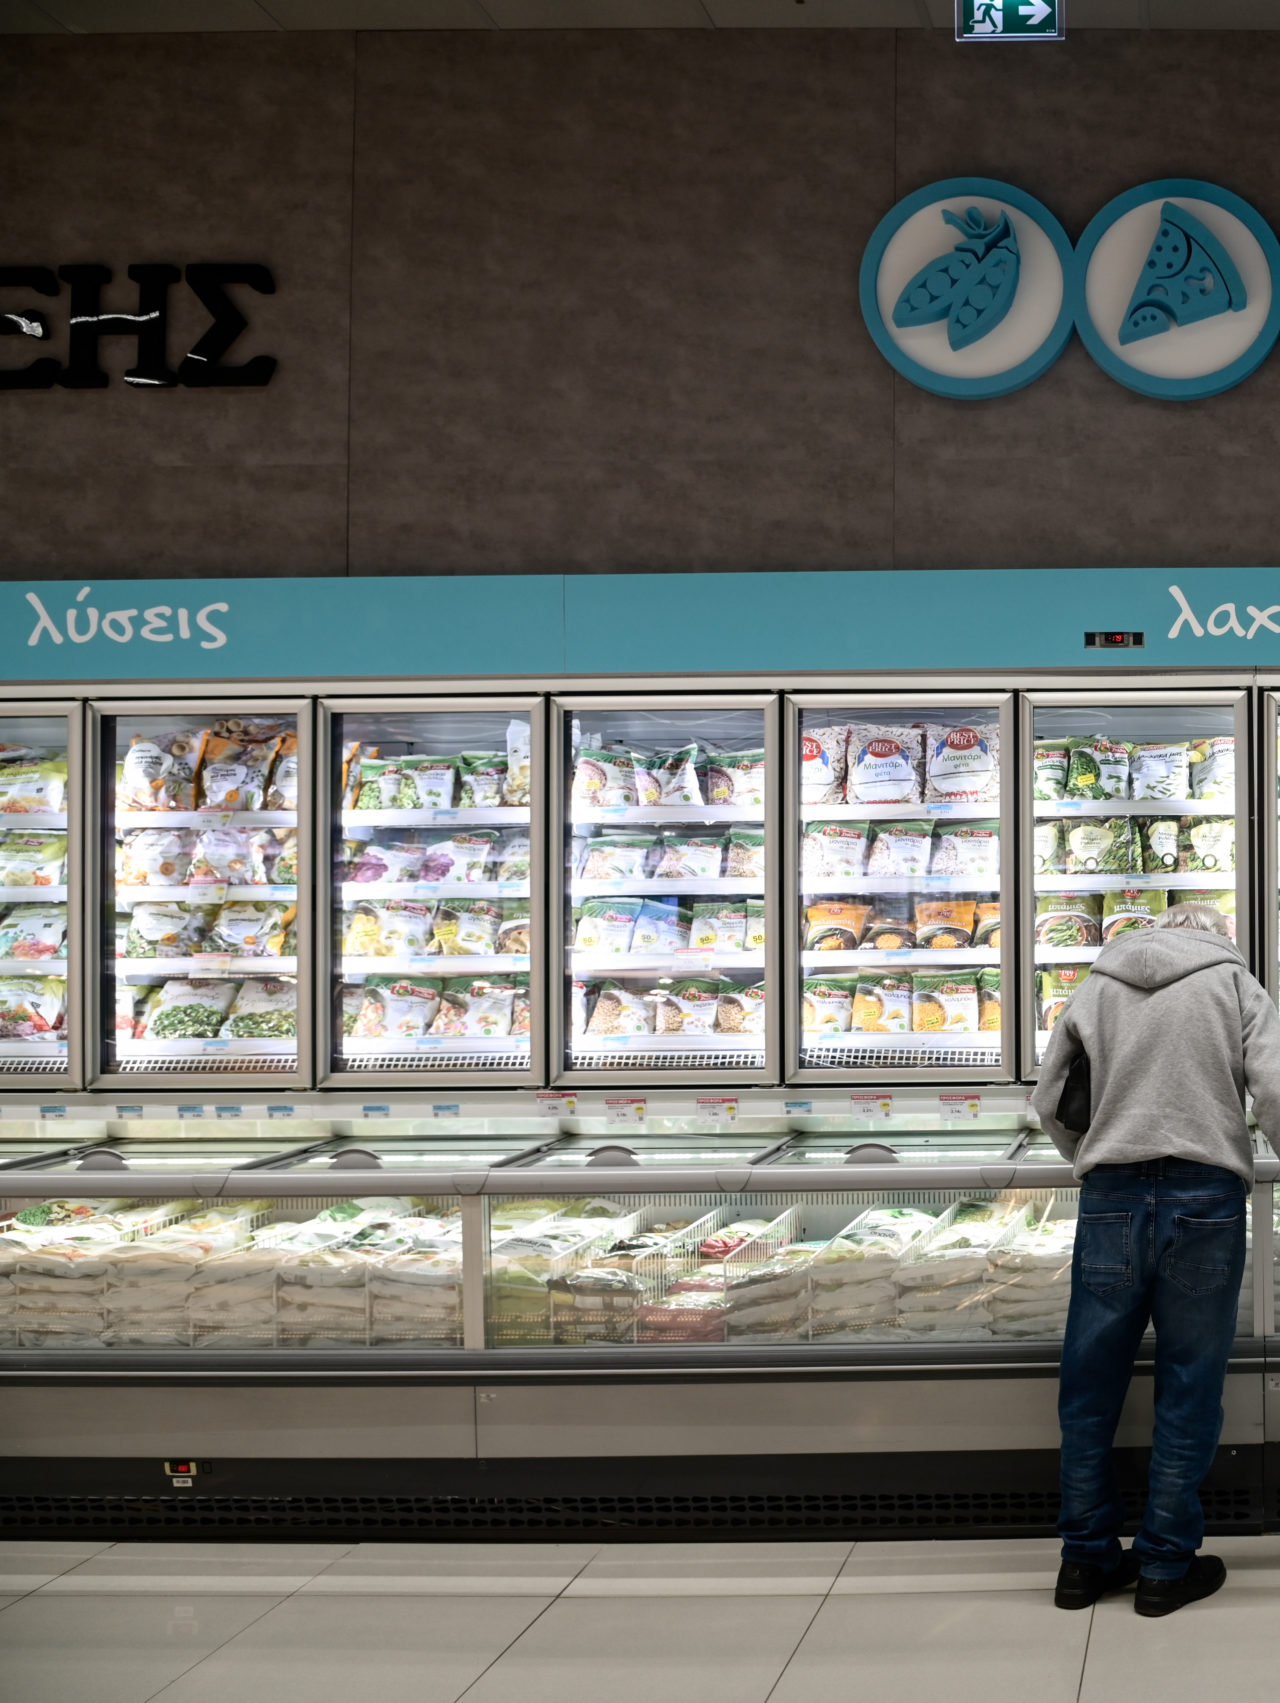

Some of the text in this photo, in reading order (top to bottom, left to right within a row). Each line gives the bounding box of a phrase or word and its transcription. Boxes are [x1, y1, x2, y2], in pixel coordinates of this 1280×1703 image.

[25, 586, 229, 649] λύσεις
[950, 731, 976, 739] BEST
[947, 736, 977, 745] PRICE
[942, 752, 981, 762] Μανιτάρι
[864, 760, 903, 770] Μανιτάρι
[1048, 903, 1085, 912] μπάμιες
[1114, 902, 1150, 913] μπάμιες
